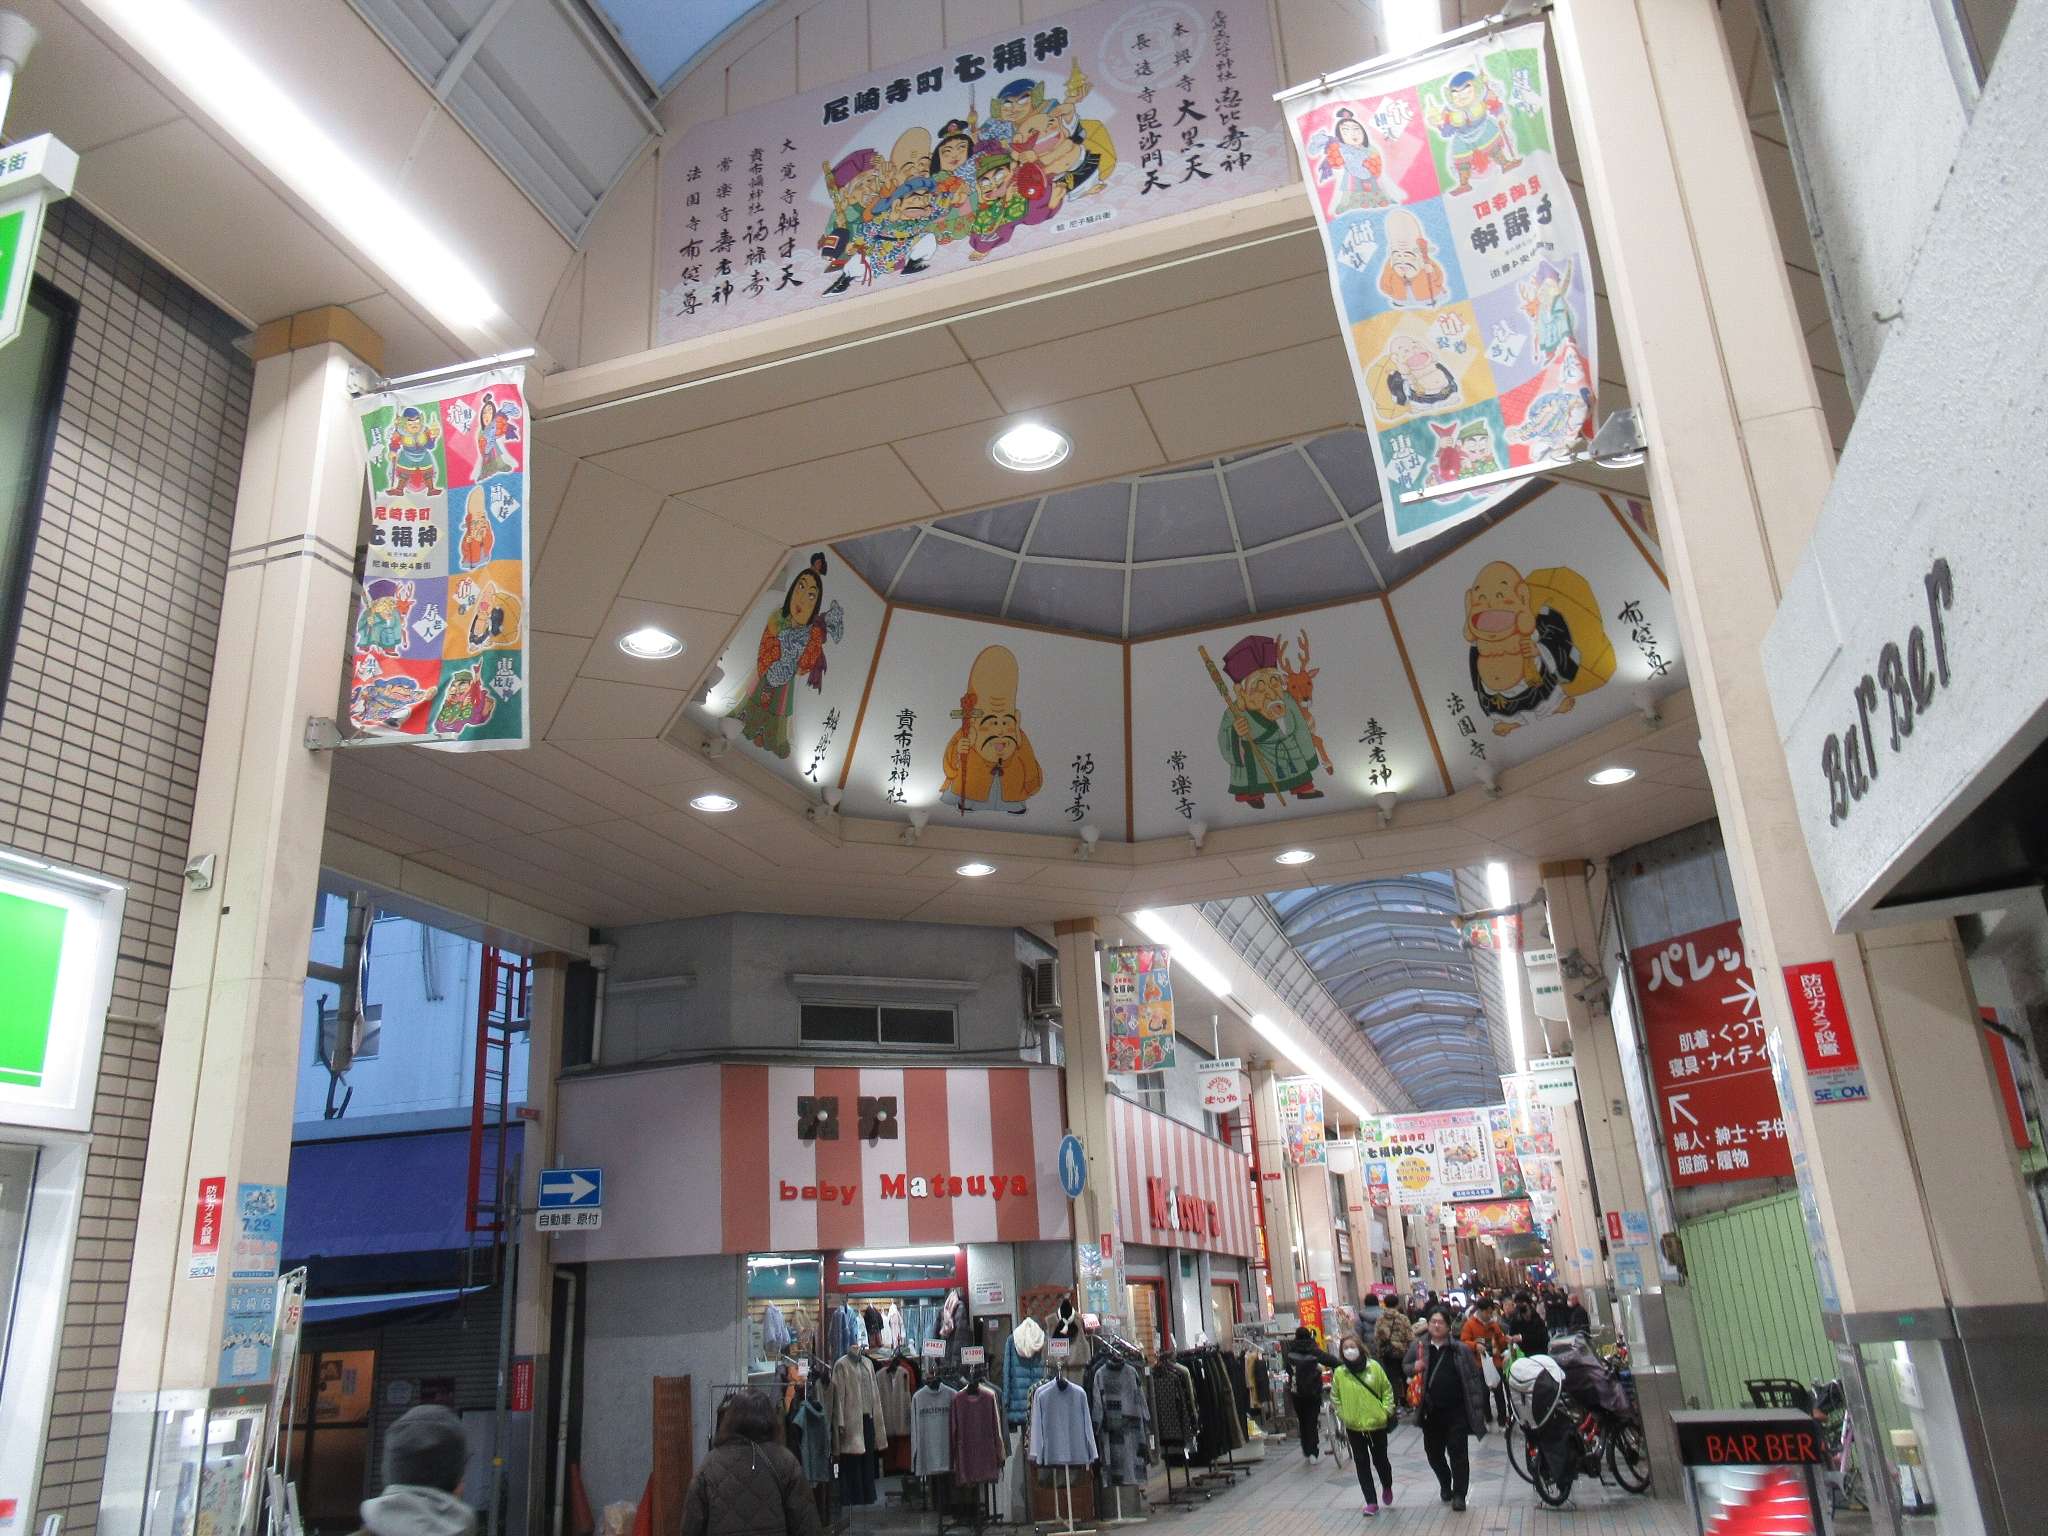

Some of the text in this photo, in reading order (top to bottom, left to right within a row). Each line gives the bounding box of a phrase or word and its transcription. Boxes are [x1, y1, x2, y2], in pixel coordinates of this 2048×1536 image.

[1800, 974, 1840, 1057] 防犯カメラ設置
[1814, 1085, 1866, 1101] SECOM
[1678, 1149, 1749, 1176] 服飾・履物
[779, 1173, 1029, 1205] baby Matsuya
[201, 1185, 217, 1246] 防犯カメラ設置
